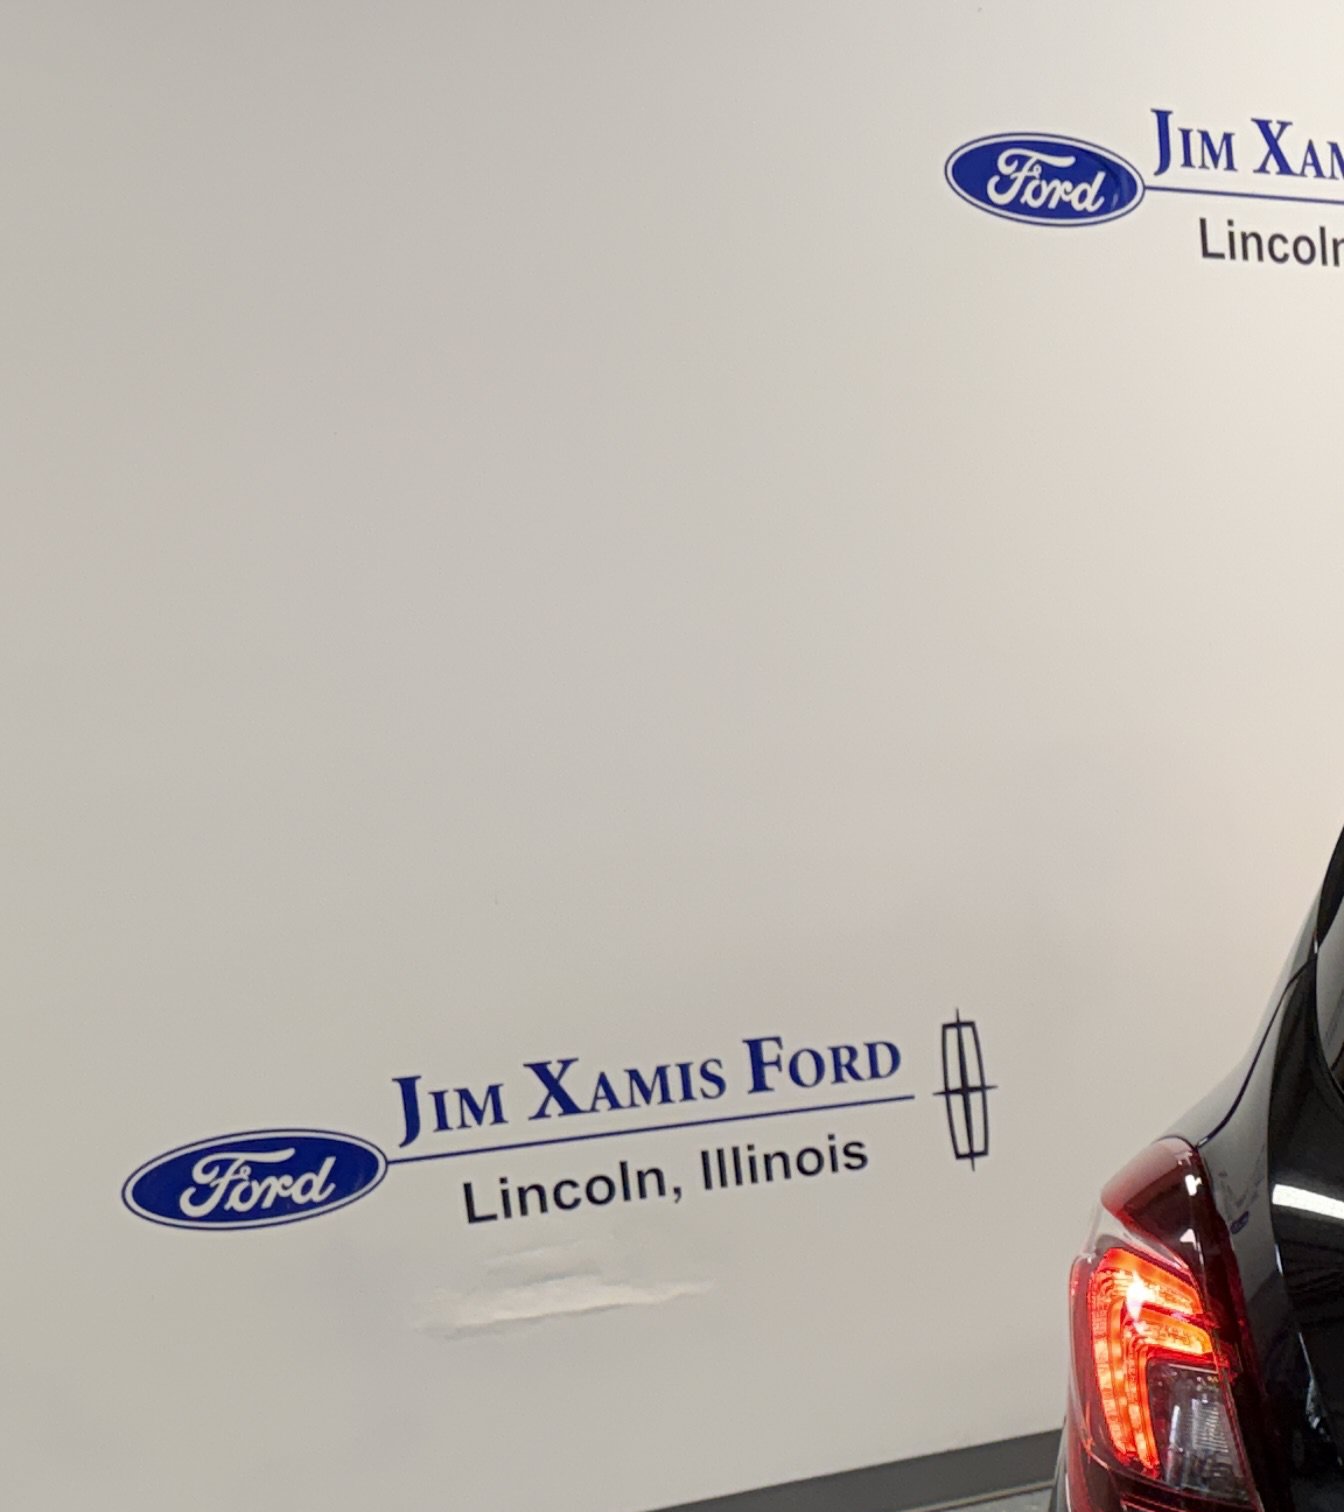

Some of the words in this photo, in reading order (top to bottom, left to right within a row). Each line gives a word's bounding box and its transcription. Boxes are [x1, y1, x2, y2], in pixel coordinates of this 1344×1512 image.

[986, 147, 1106, 213] Ford
[741, 1034, 903, 1096] FORD
[177, 1148, 337, 1217] Ford
[462, 1160, 684, 1225] Lincoln,
[699, 1133, 869, 1192] Illinois
